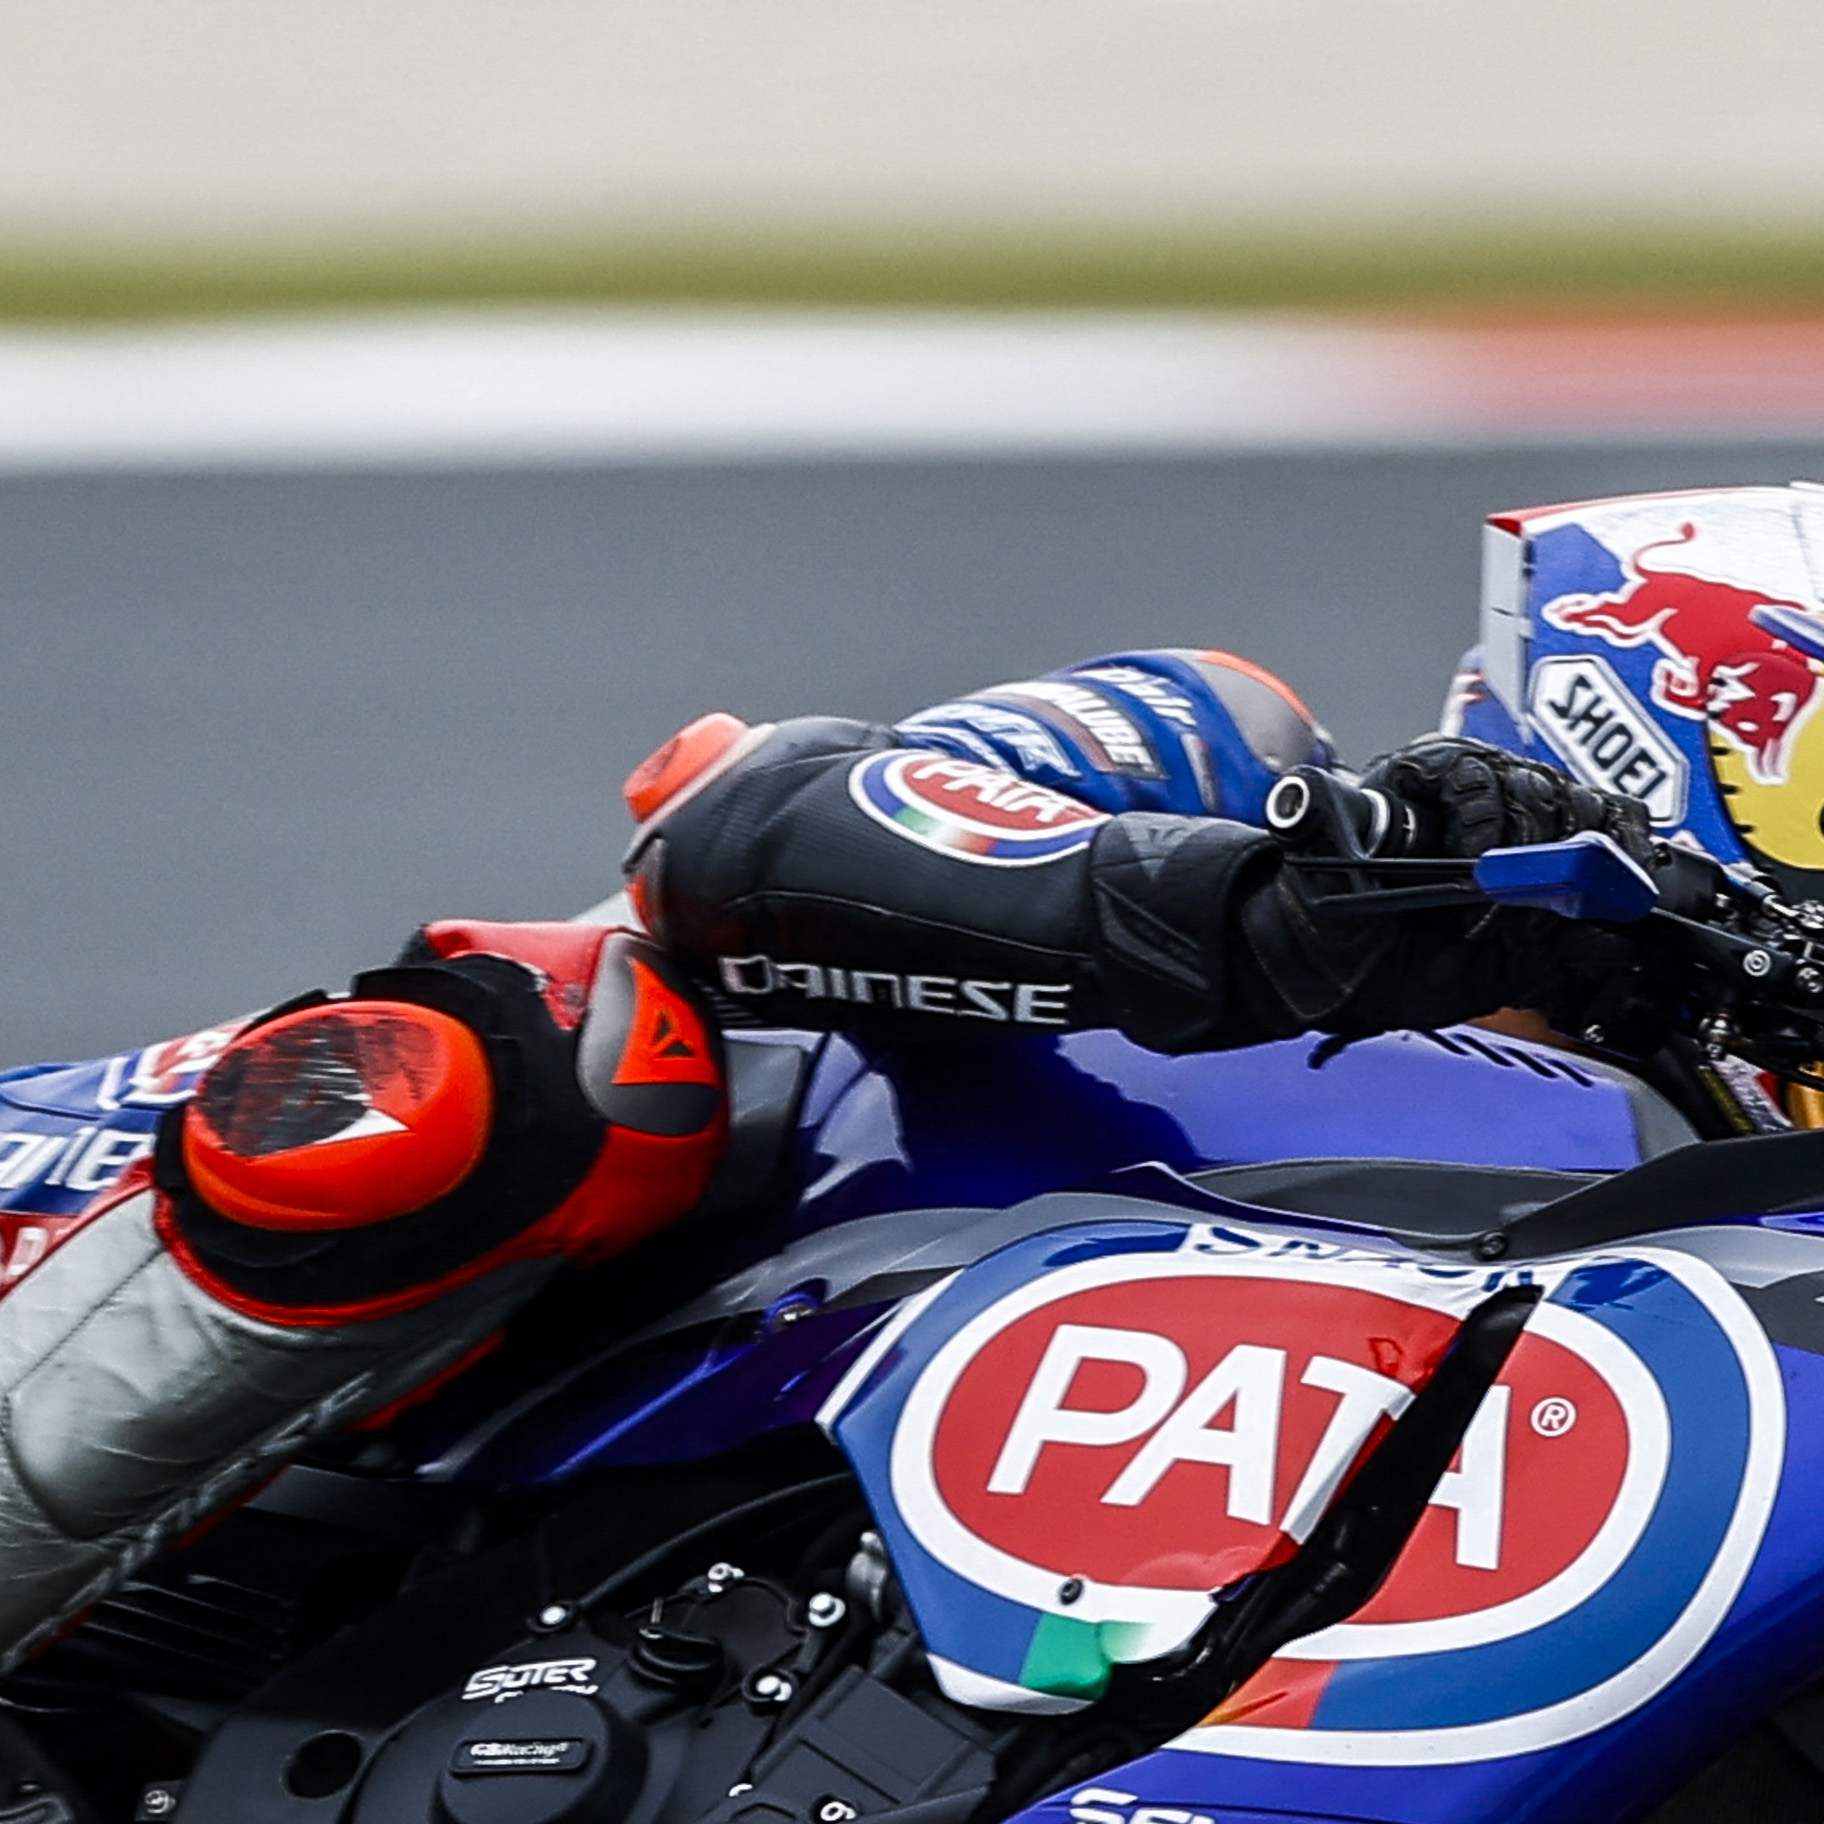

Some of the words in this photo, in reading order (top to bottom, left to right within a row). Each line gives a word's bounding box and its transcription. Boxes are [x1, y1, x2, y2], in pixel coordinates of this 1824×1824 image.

[1549, 674, 1667, 799] SHOEI
[912, 760, 1064, 823] PATA
[720, 954, 1072, 1026] DAINESE
[986, 1323, 1509, 1572] PATA
[461, 1657, 597, 1700] SUTER
